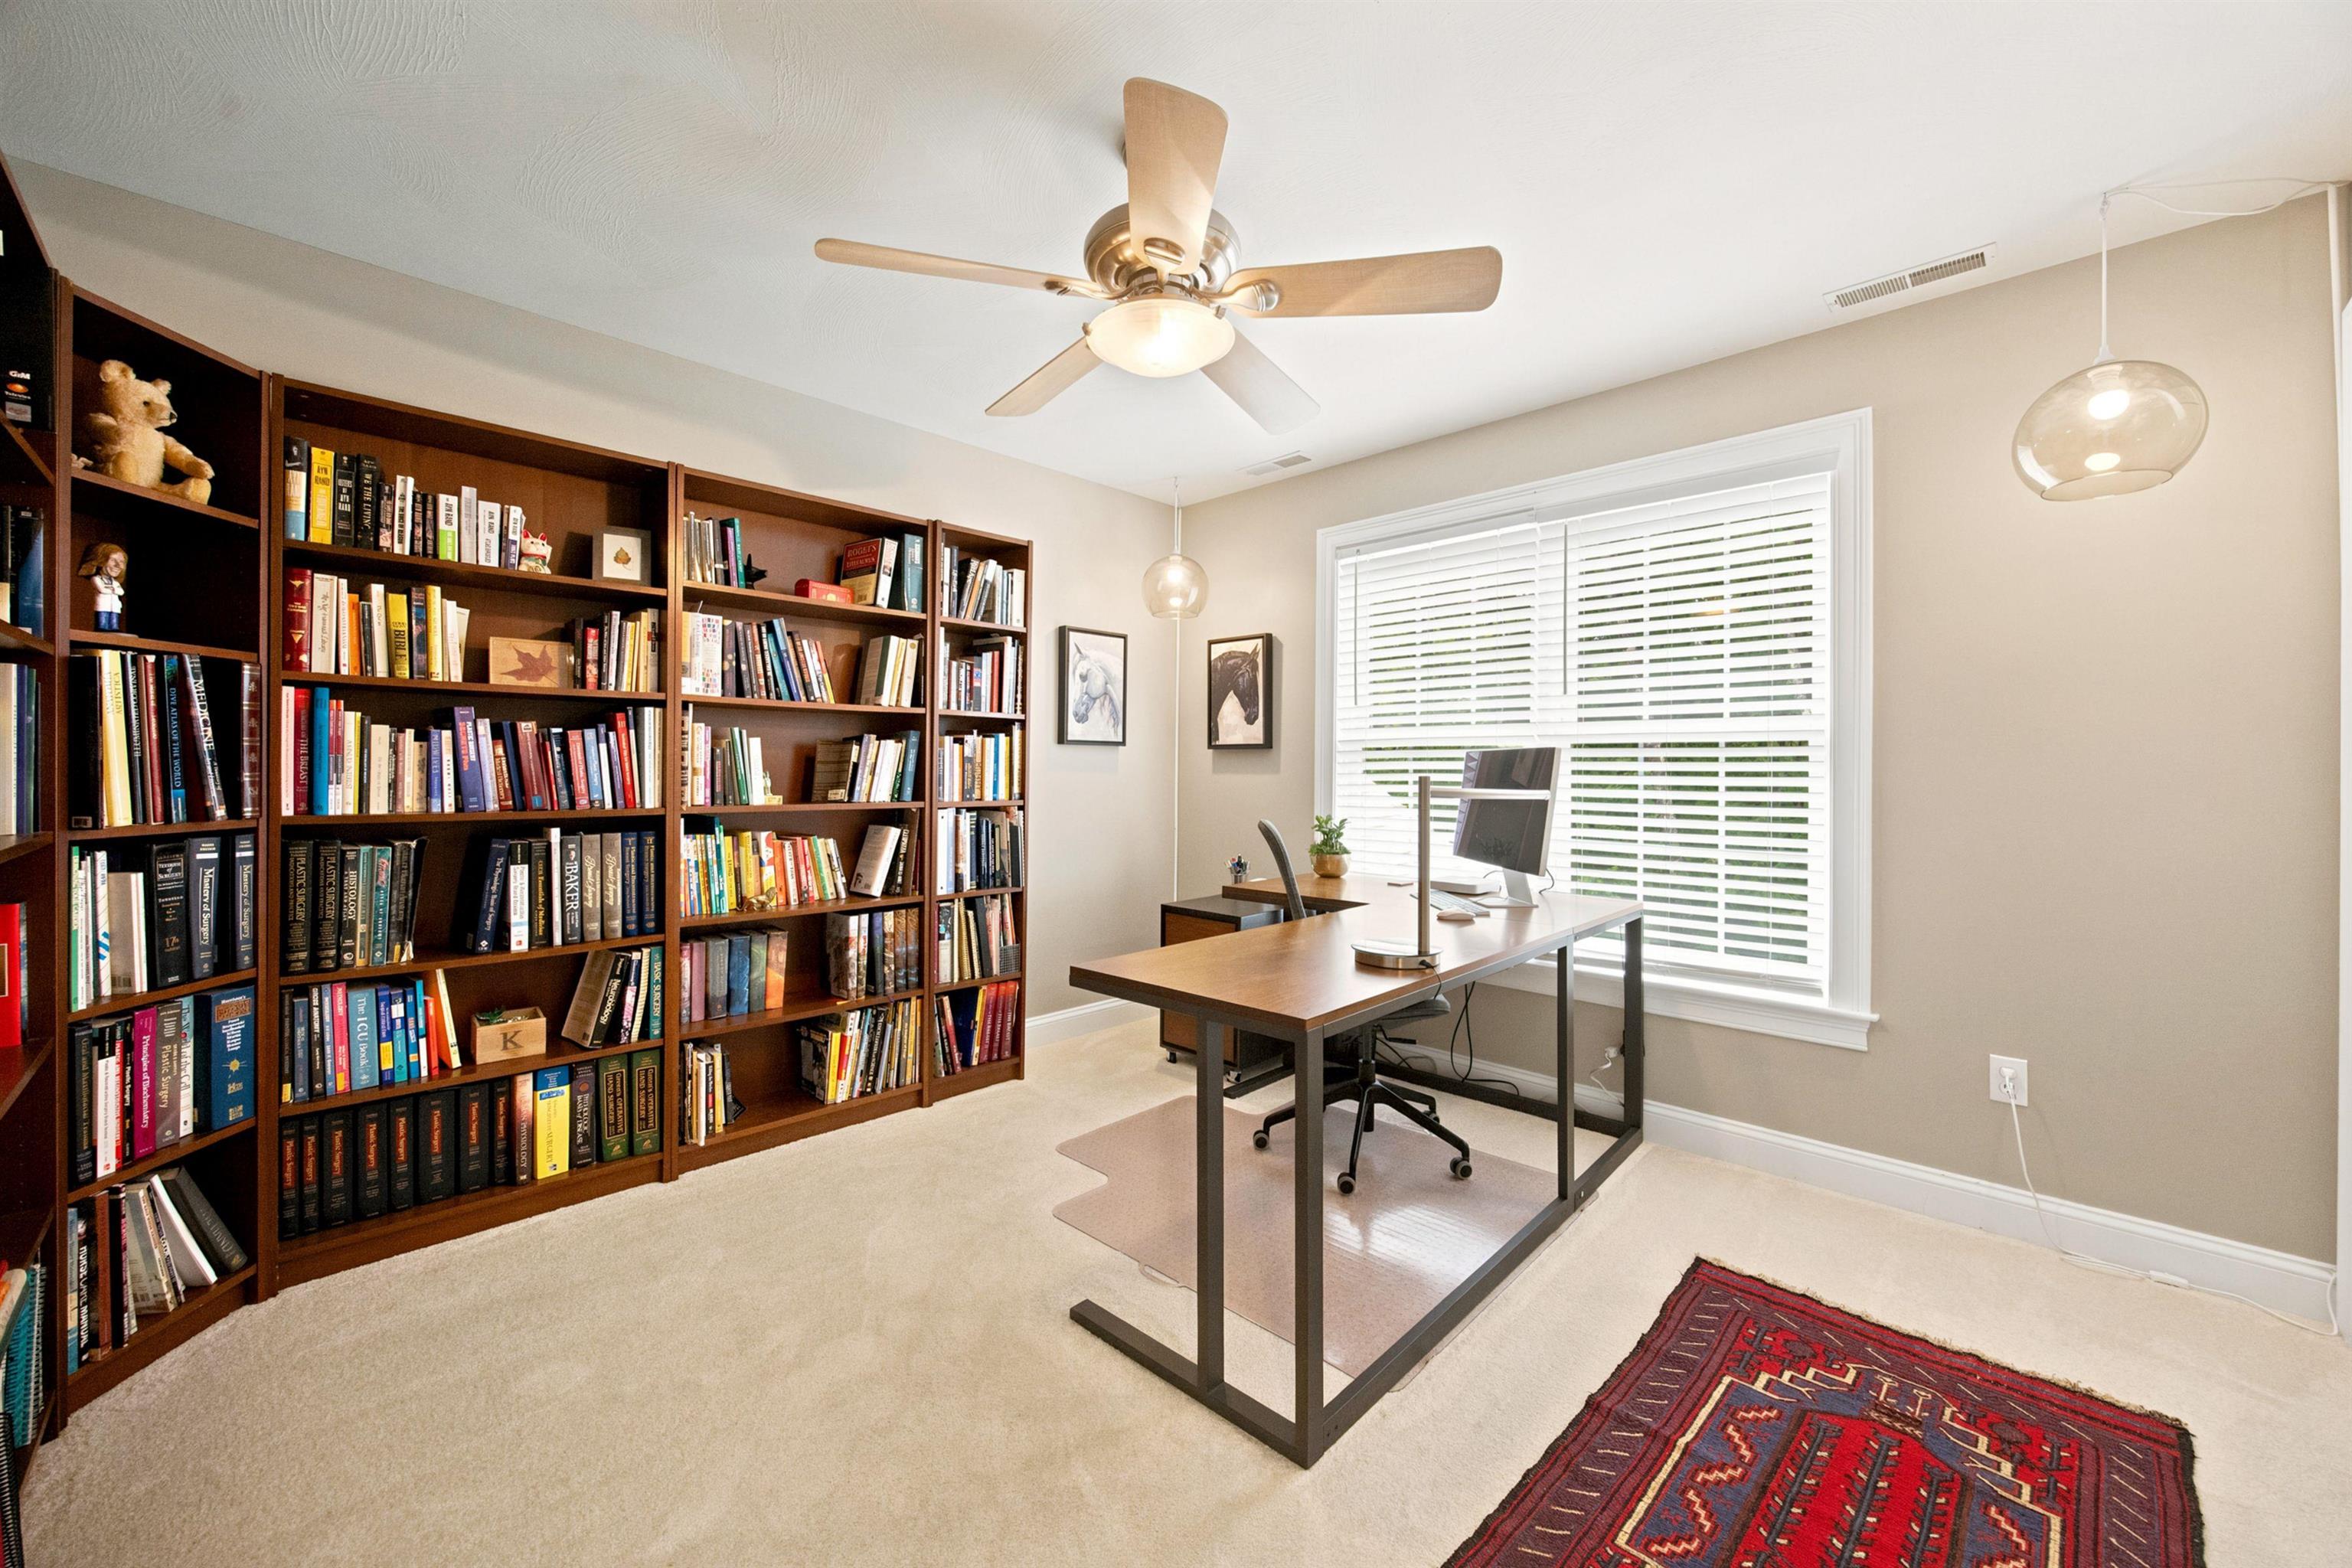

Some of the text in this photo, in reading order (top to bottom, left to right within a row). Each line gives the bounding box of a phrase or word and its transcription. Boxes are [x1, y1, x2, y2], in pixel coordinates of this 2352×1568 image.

[315, 475, 330, 486] RAND
[317, 466, 328, 475] AYN
[364, 473, 372, 485] WE
[338, 502, 351, 511] RAND
[340, 494, 350, 502] AYN
[363, 486, 372, 501] THE
[394, 629, 407, 661] BIBLE
[194, 678, 215, 751] MEDICINE
[171, 730, 178, 740] OF
[173, 759, 181, 788] WORLD
[299, 738, 309, 785] THE BREAST
[202, 867, 215, 903] Mastery
[242, 864, 252, 897] Mastery
[296, 857, 306, 921] PLASTIC SURGERY
[325, 856, 336, 920] PLASTIC SURGERY
[348, 871, 357, 920] HISTOLOGY
[201, 913, 211, 946] Surgery
[242, 906, 250, 938] Surgery
[599, 978, 622, 1025] Neurobiology
[652, 961, 662, 1017] BASIC SURGERY
[357, 997, 366, 1014] The
[142, 1035, 152, 1072] Principles
[358, 1043, 371, 1067] Book
[499, 1029, 524, 1051] K
[158, 1044, 172, 1108] Plastic Surgery
[181, 1074, 191, 1091] Cell
[141, 1081, 151, 1129] Biochemistry
[397, 1116, 407, 1161] Plastic Surgery
[432, 1130, 440, 1152] Surgery
[469, 1122, 479, 1145] Surgery
[332, 1130, 343, 1175] Plastic Surgery
[368, 1145, 377, 1168] Surgery
[80, 1307, 89, 1348] MANUAL
